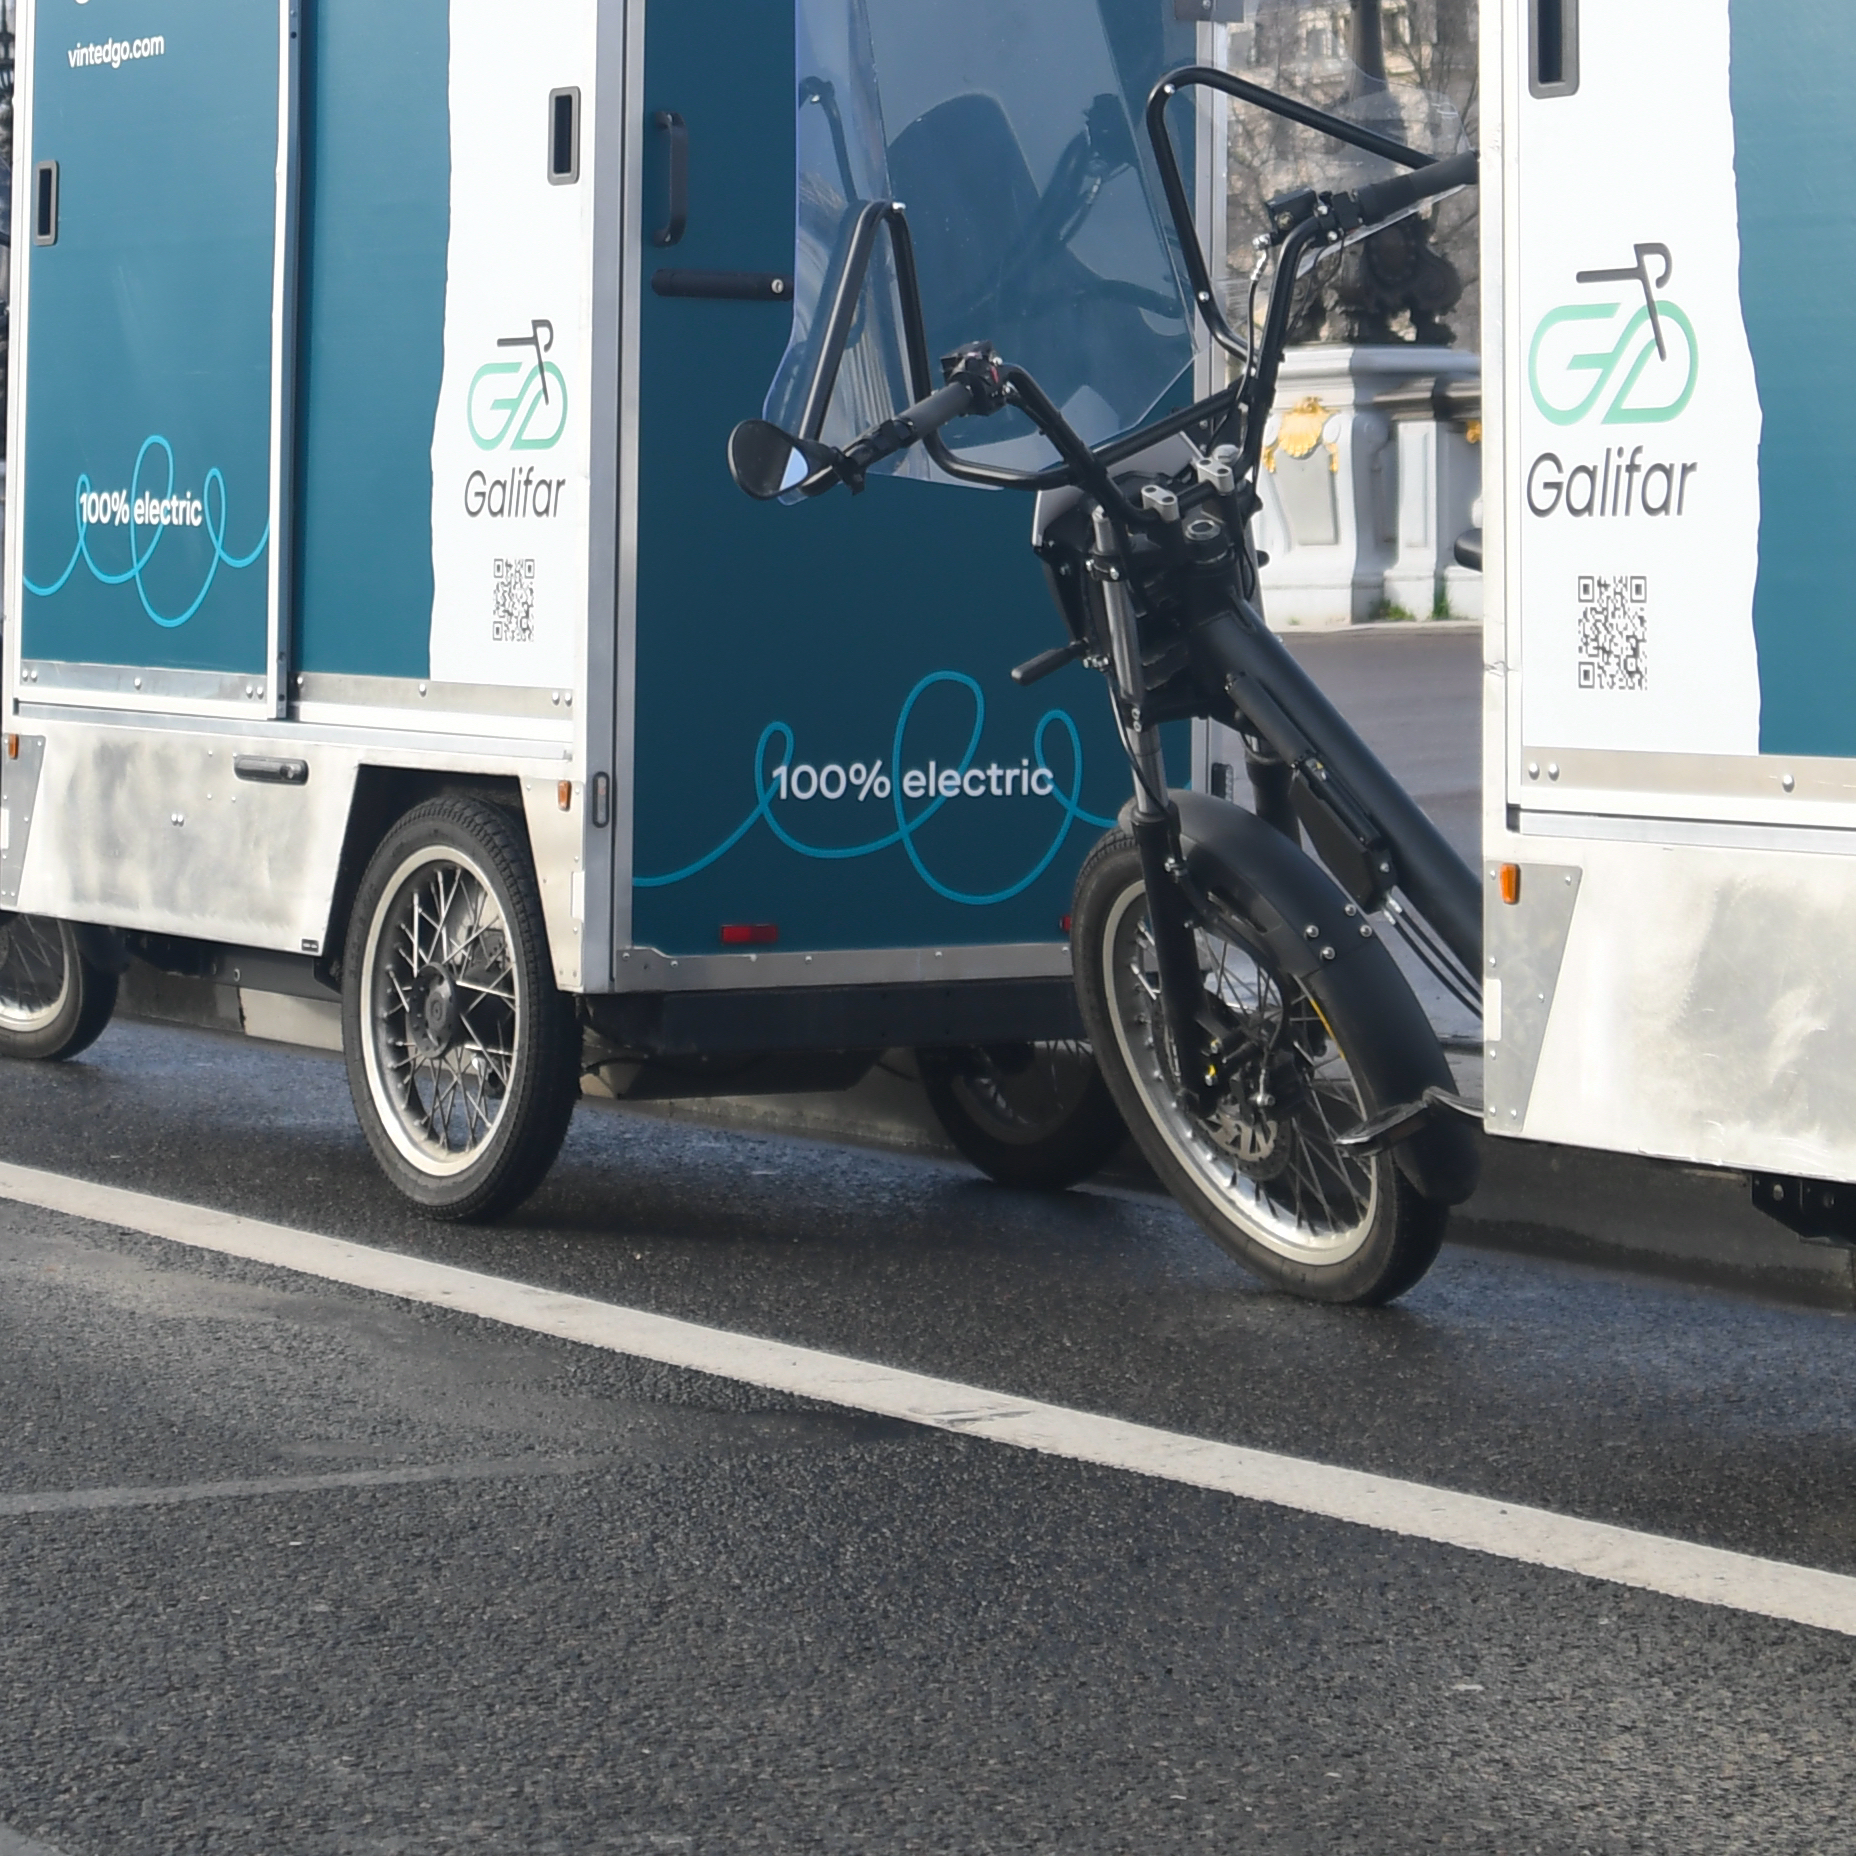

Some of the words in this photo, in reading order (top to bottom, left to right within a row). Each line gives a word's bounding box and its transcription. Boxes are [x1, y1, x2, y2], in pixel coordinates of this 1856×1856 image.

[67, 34, 165, 69] vintedgo.com
[464, 465, 566, 519] Galifar
[1526, 445, 1698, 520] Galifar
[79, 489, 130, 527] 100%
[133, 491, 203, 527] electric
[771, 759, 891, 802] 100%
[902, 758, 1054, 798] electric
